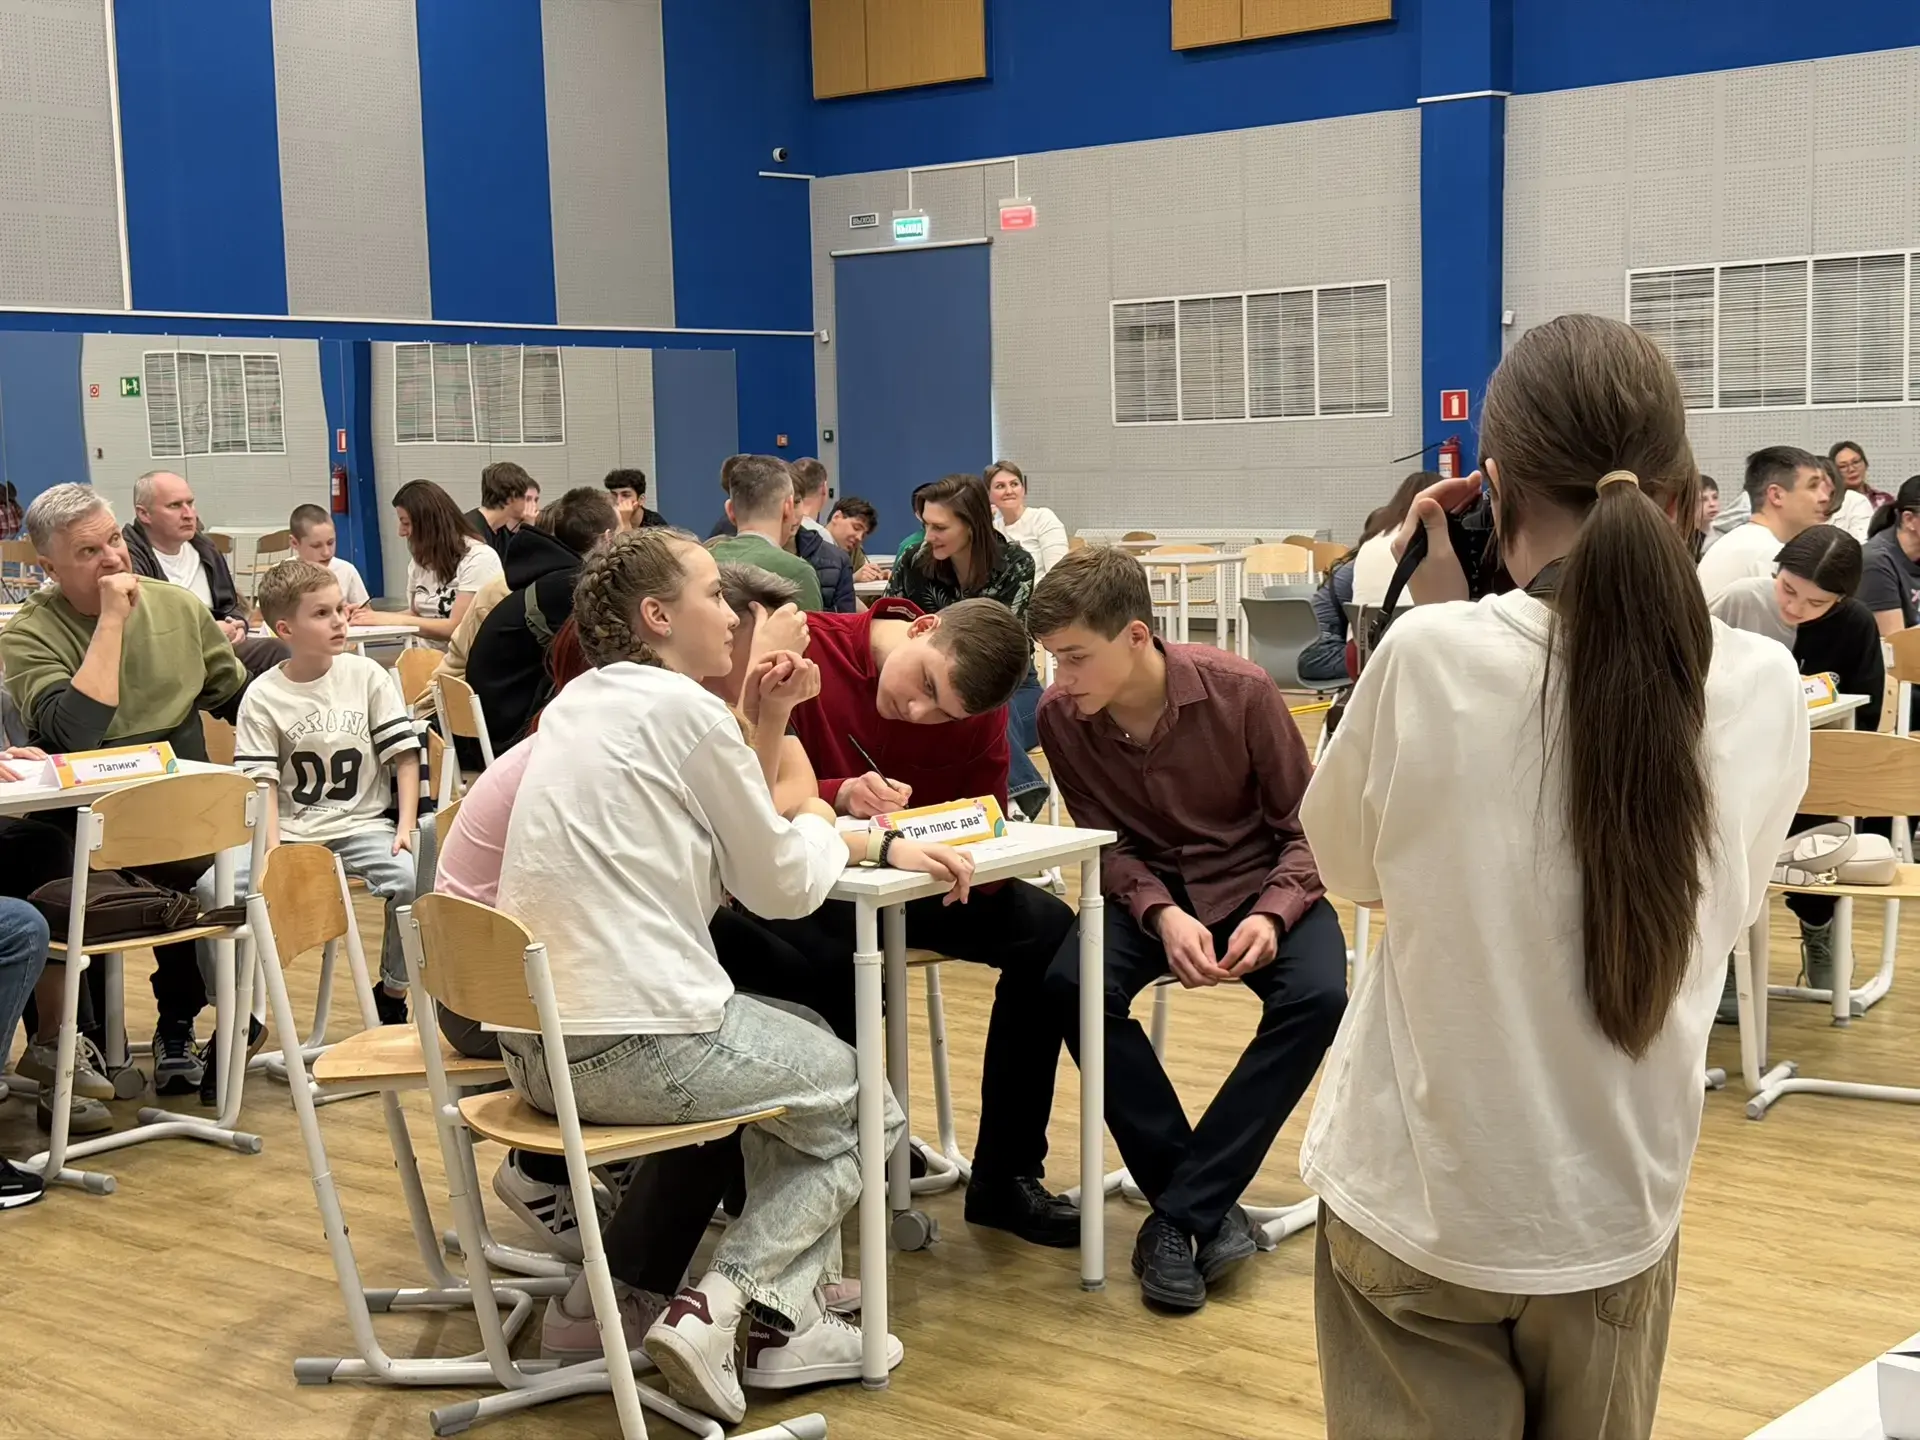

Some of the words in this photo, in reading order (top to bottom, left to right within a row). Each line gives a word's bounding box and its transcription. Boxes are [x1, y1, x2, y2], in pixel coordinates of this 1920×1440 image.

[852, 215, 875, 225] ВЫХОД
[290, 747, 363, 805] 09
[901, 825, 928, 839] "Три
[929, 820, 958, 834] плюс
[960, 813, 983, 829] два"
